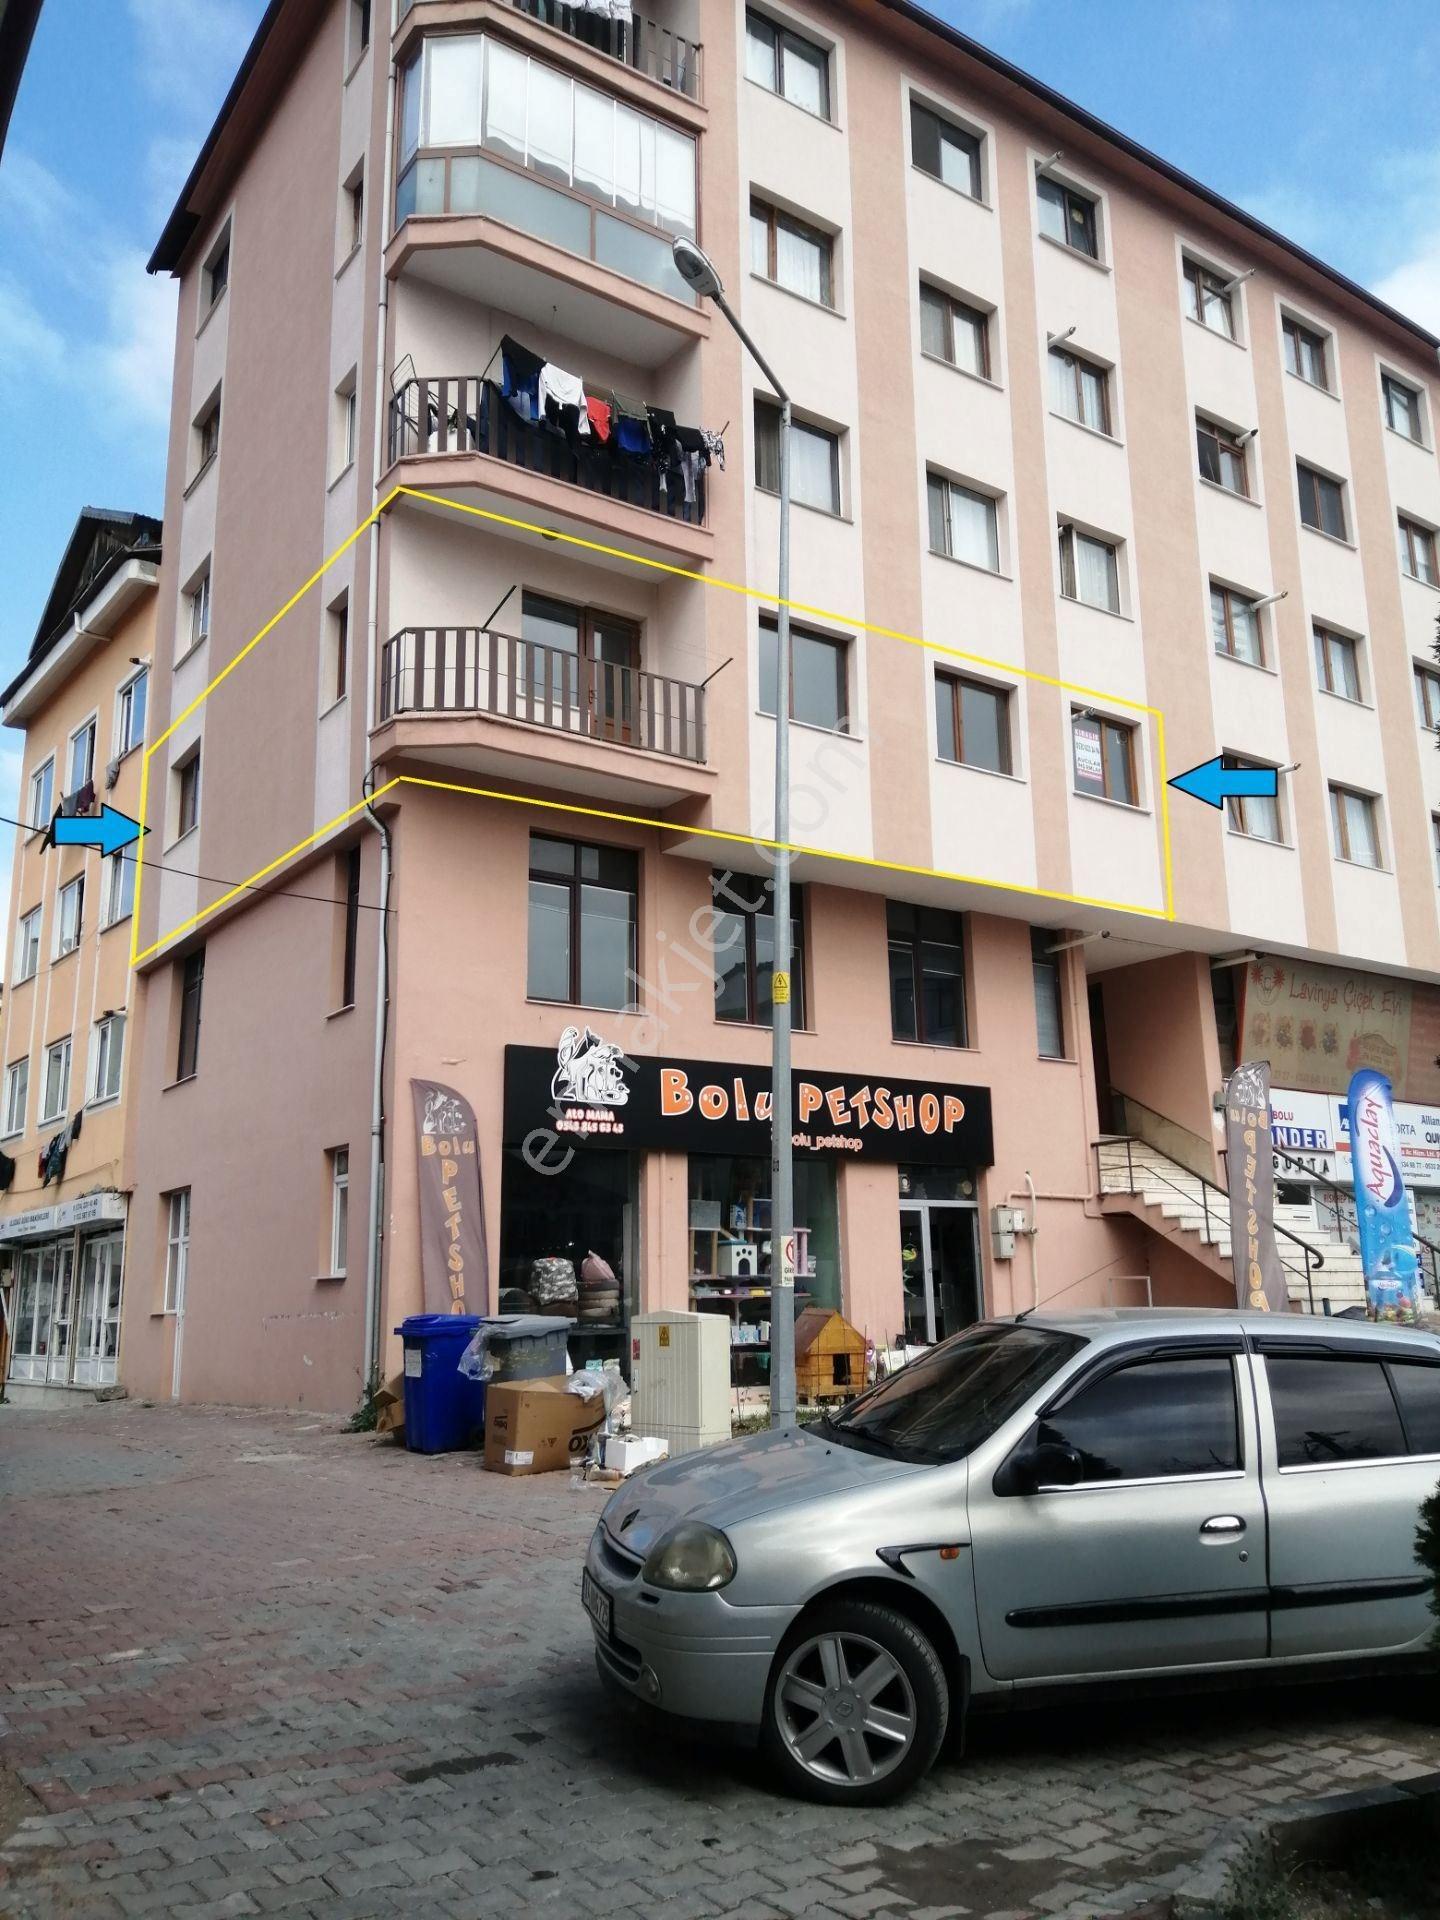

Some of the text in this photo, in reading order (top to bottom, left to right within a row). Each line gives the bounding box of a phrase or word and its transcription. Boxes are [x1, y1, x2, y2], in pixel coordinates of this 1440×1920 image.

[1289, 973, 1338, 1012] Lavinya
[660, 1068, 965, 1135] Bolu PETSHOP
[565, 1108, 615, 1122] ALO MAMA
[1273, 1110, 1294, 1121] BOLU
[421, 1135, 475, 1157] Bolu
[792, 1133, 863, 1152] olu_petshop
